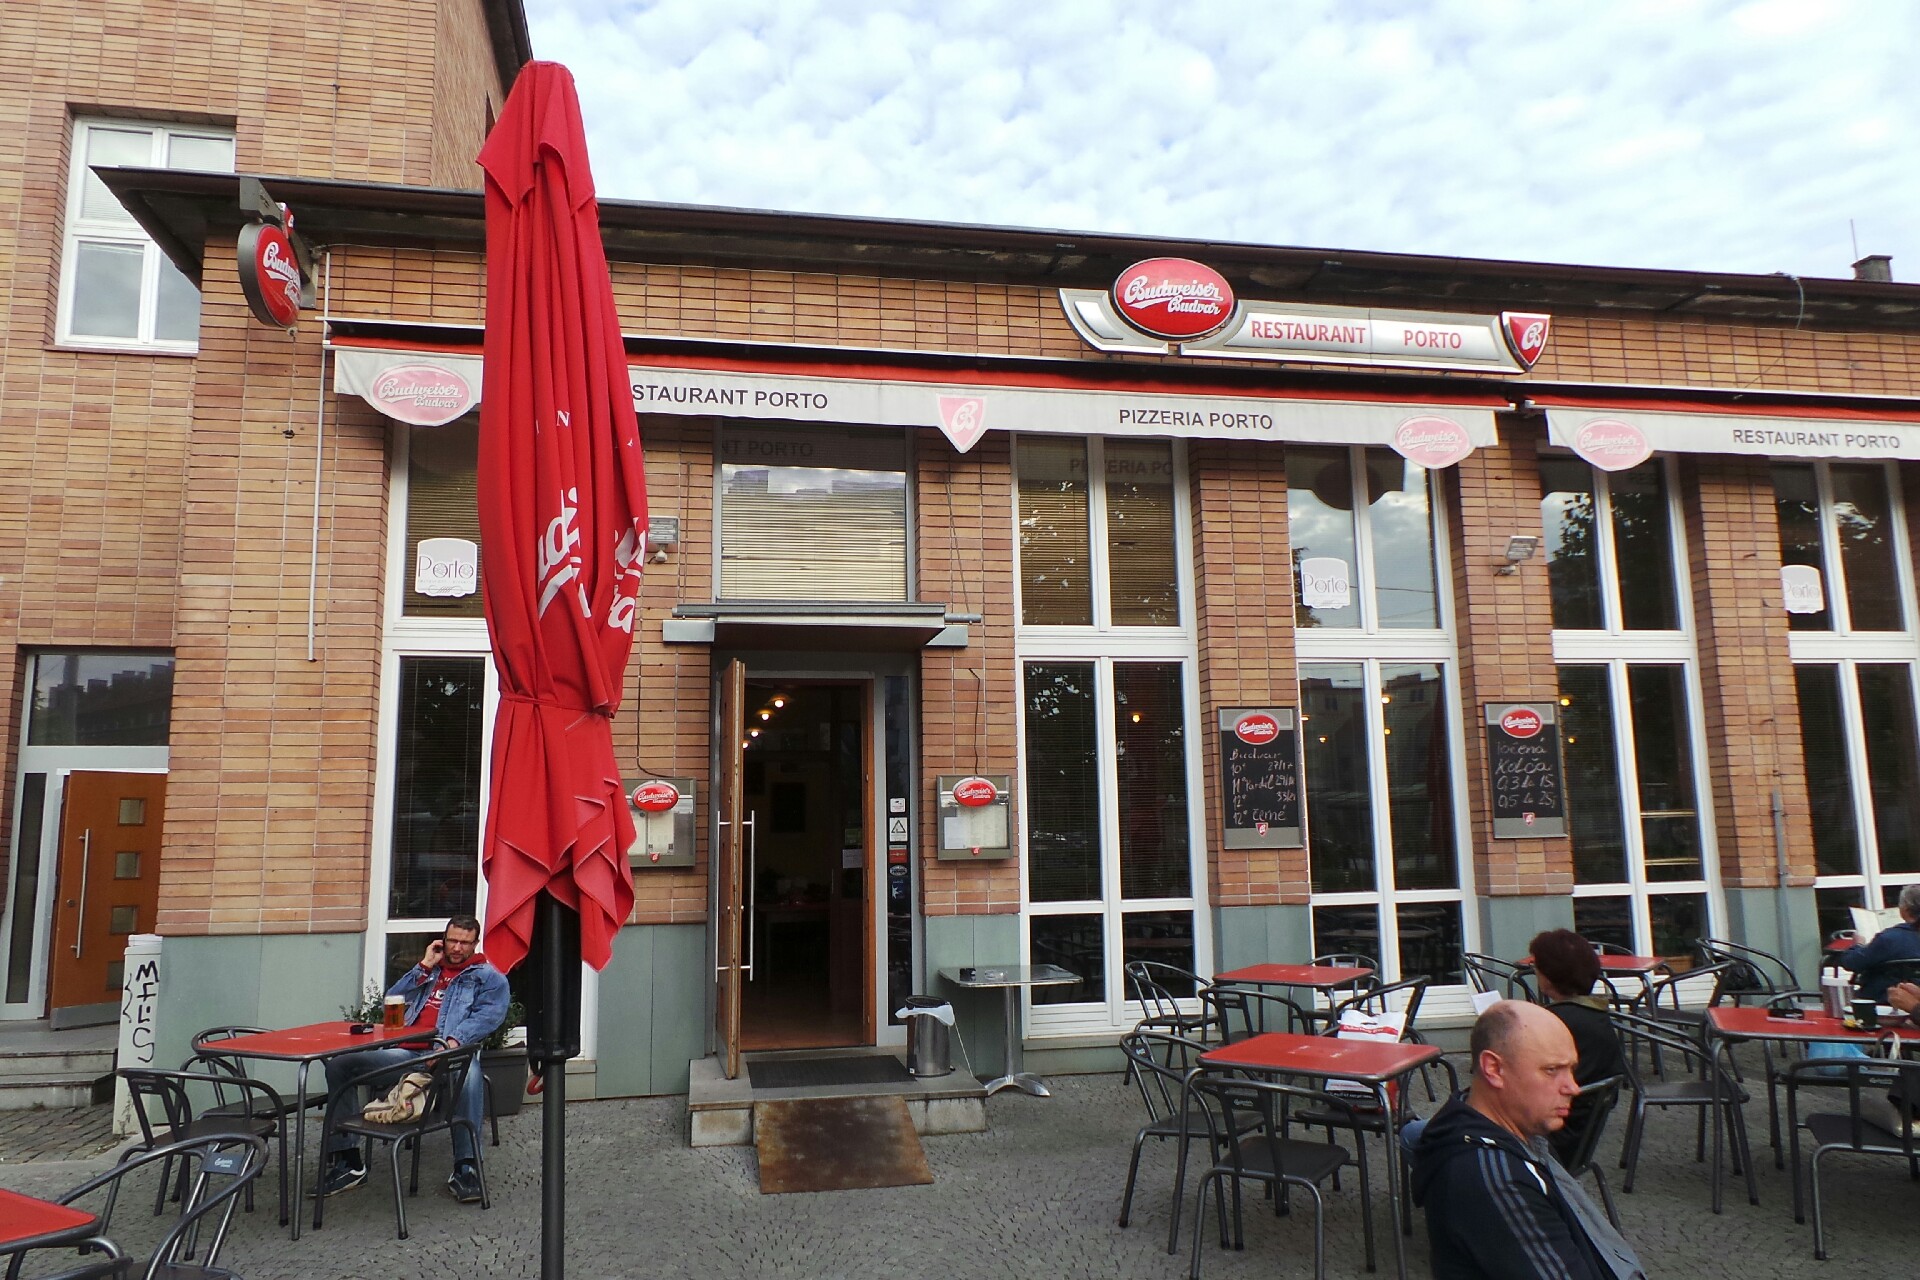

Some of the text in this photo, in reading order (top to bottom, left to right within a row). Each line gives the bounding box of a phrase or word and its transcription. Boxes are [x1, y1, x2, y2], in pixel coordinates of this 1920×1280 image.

[1124, 275, 1222, 303] Budweiser
[1167, 295, 1221, 315] Budvar
[1251, 320, 1462, 349] RESTAURANT PORTO
[378, 377, 462, 400] Budweiser
[414, 394, 460, 409] Budvar
[755, 390, 829, 409] PORTO
[1119, 409, 1273, 430] PIZZERIA PORTO
[1732, 429, 1900, 449] RESTAURANT PORTO
[418, 555, 474, 579] Porto
[1303, 573, 1348, 593] Porto
